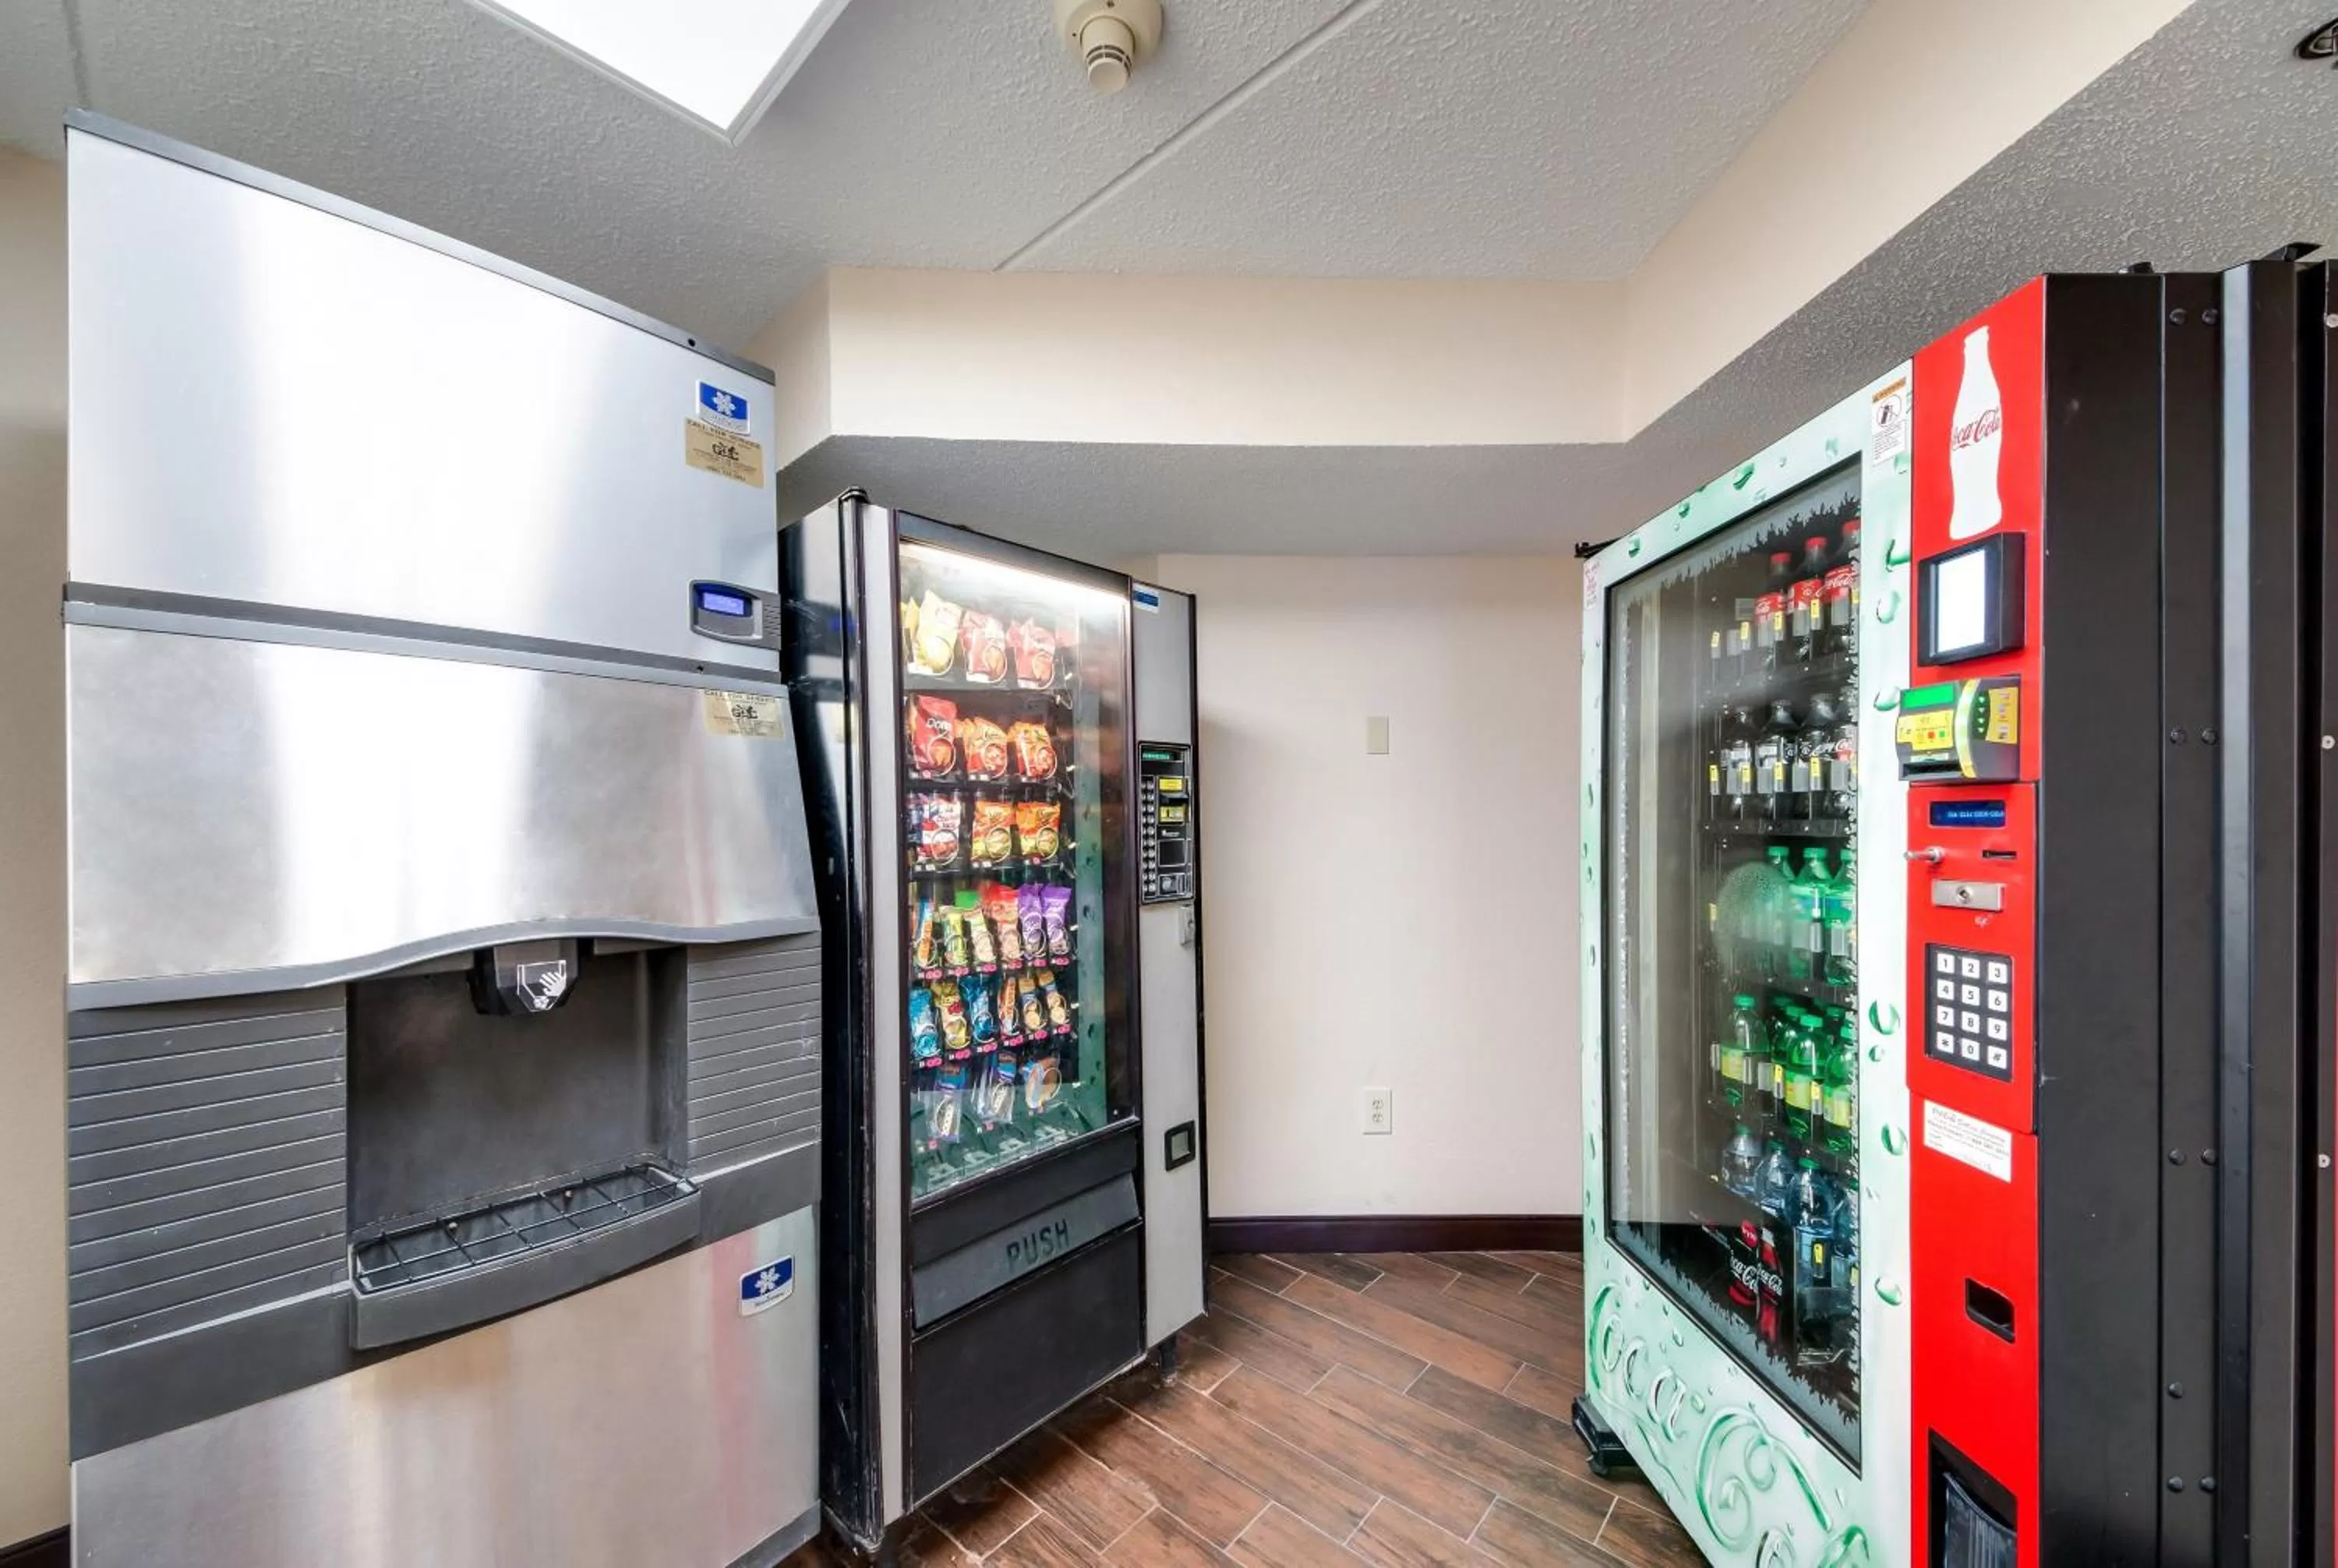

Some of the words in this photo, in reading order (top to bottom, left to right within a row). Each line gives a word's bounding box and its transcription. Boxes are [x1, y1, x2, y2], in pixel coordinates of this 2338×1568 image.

[1943, 958, 1948, 969] 1
[1968, 963, 1974, 973] 2
[1994, 967, 2001, 978] 3
[1942, 984, 1949, 994] 4
[1967, 991, 1974, 1001] 5
[1994, 996, 2001, 1006] 6
[1942, 1011, 1949, 1021] 7
[1967, 1017, 1974, 1027] 8
[1994, 1023, 2001, 1034] 9
[1967, 1045, 1974, 1054] 0
[1005, 1217, 1071, 1273] PUSH
